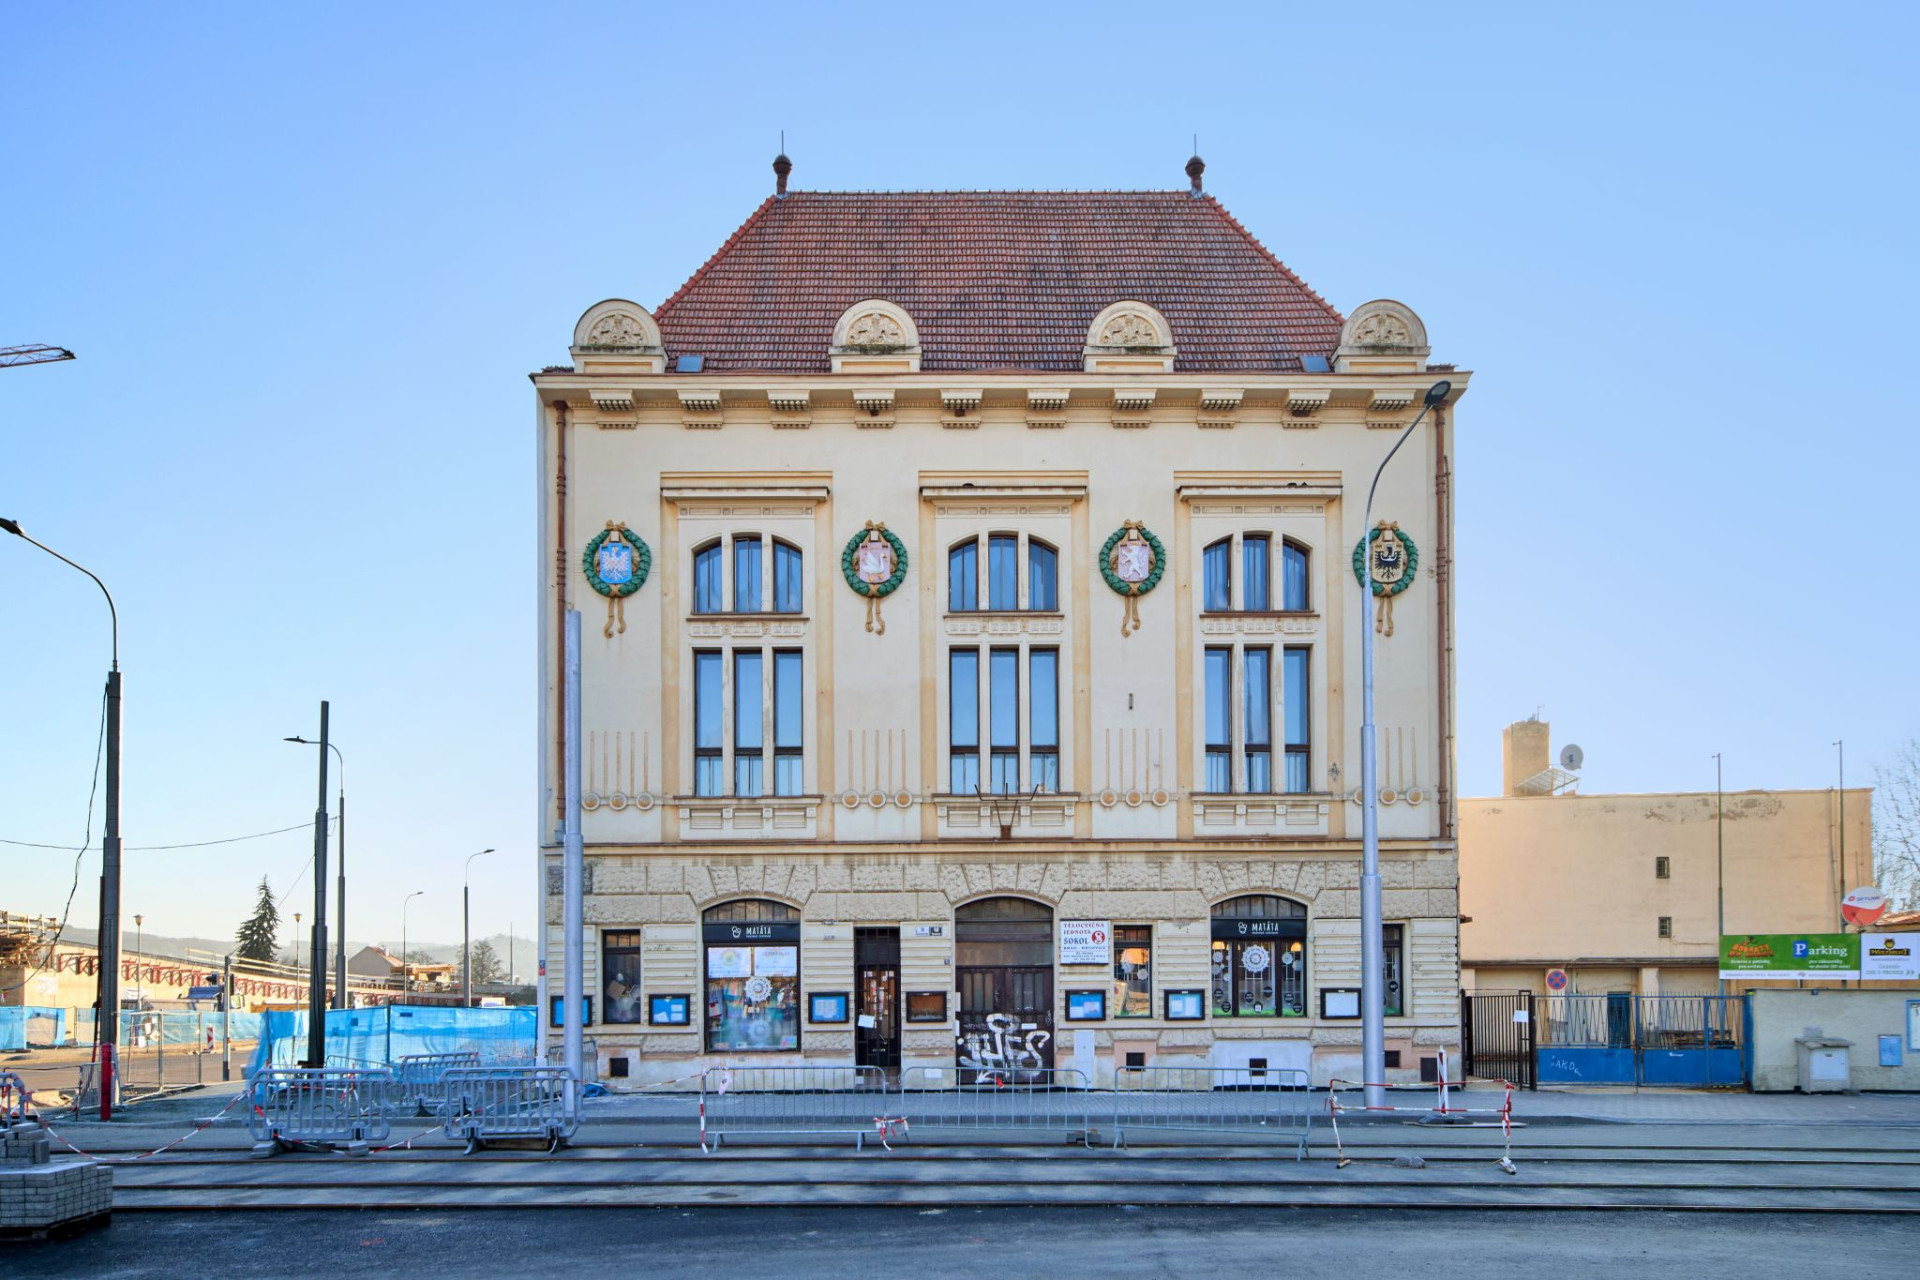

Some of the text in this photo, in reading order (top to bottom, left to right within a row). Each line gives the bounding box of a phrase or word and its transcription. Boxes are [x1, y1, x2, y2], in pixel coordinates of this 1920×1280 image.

[745, 925, 772, 935] MATÁTA
[1252, 921, 1279, 931] MATÁTA
[1063, 937, 1090, 945] SOKOL
[1795, 943, 1848, 957] Parking
